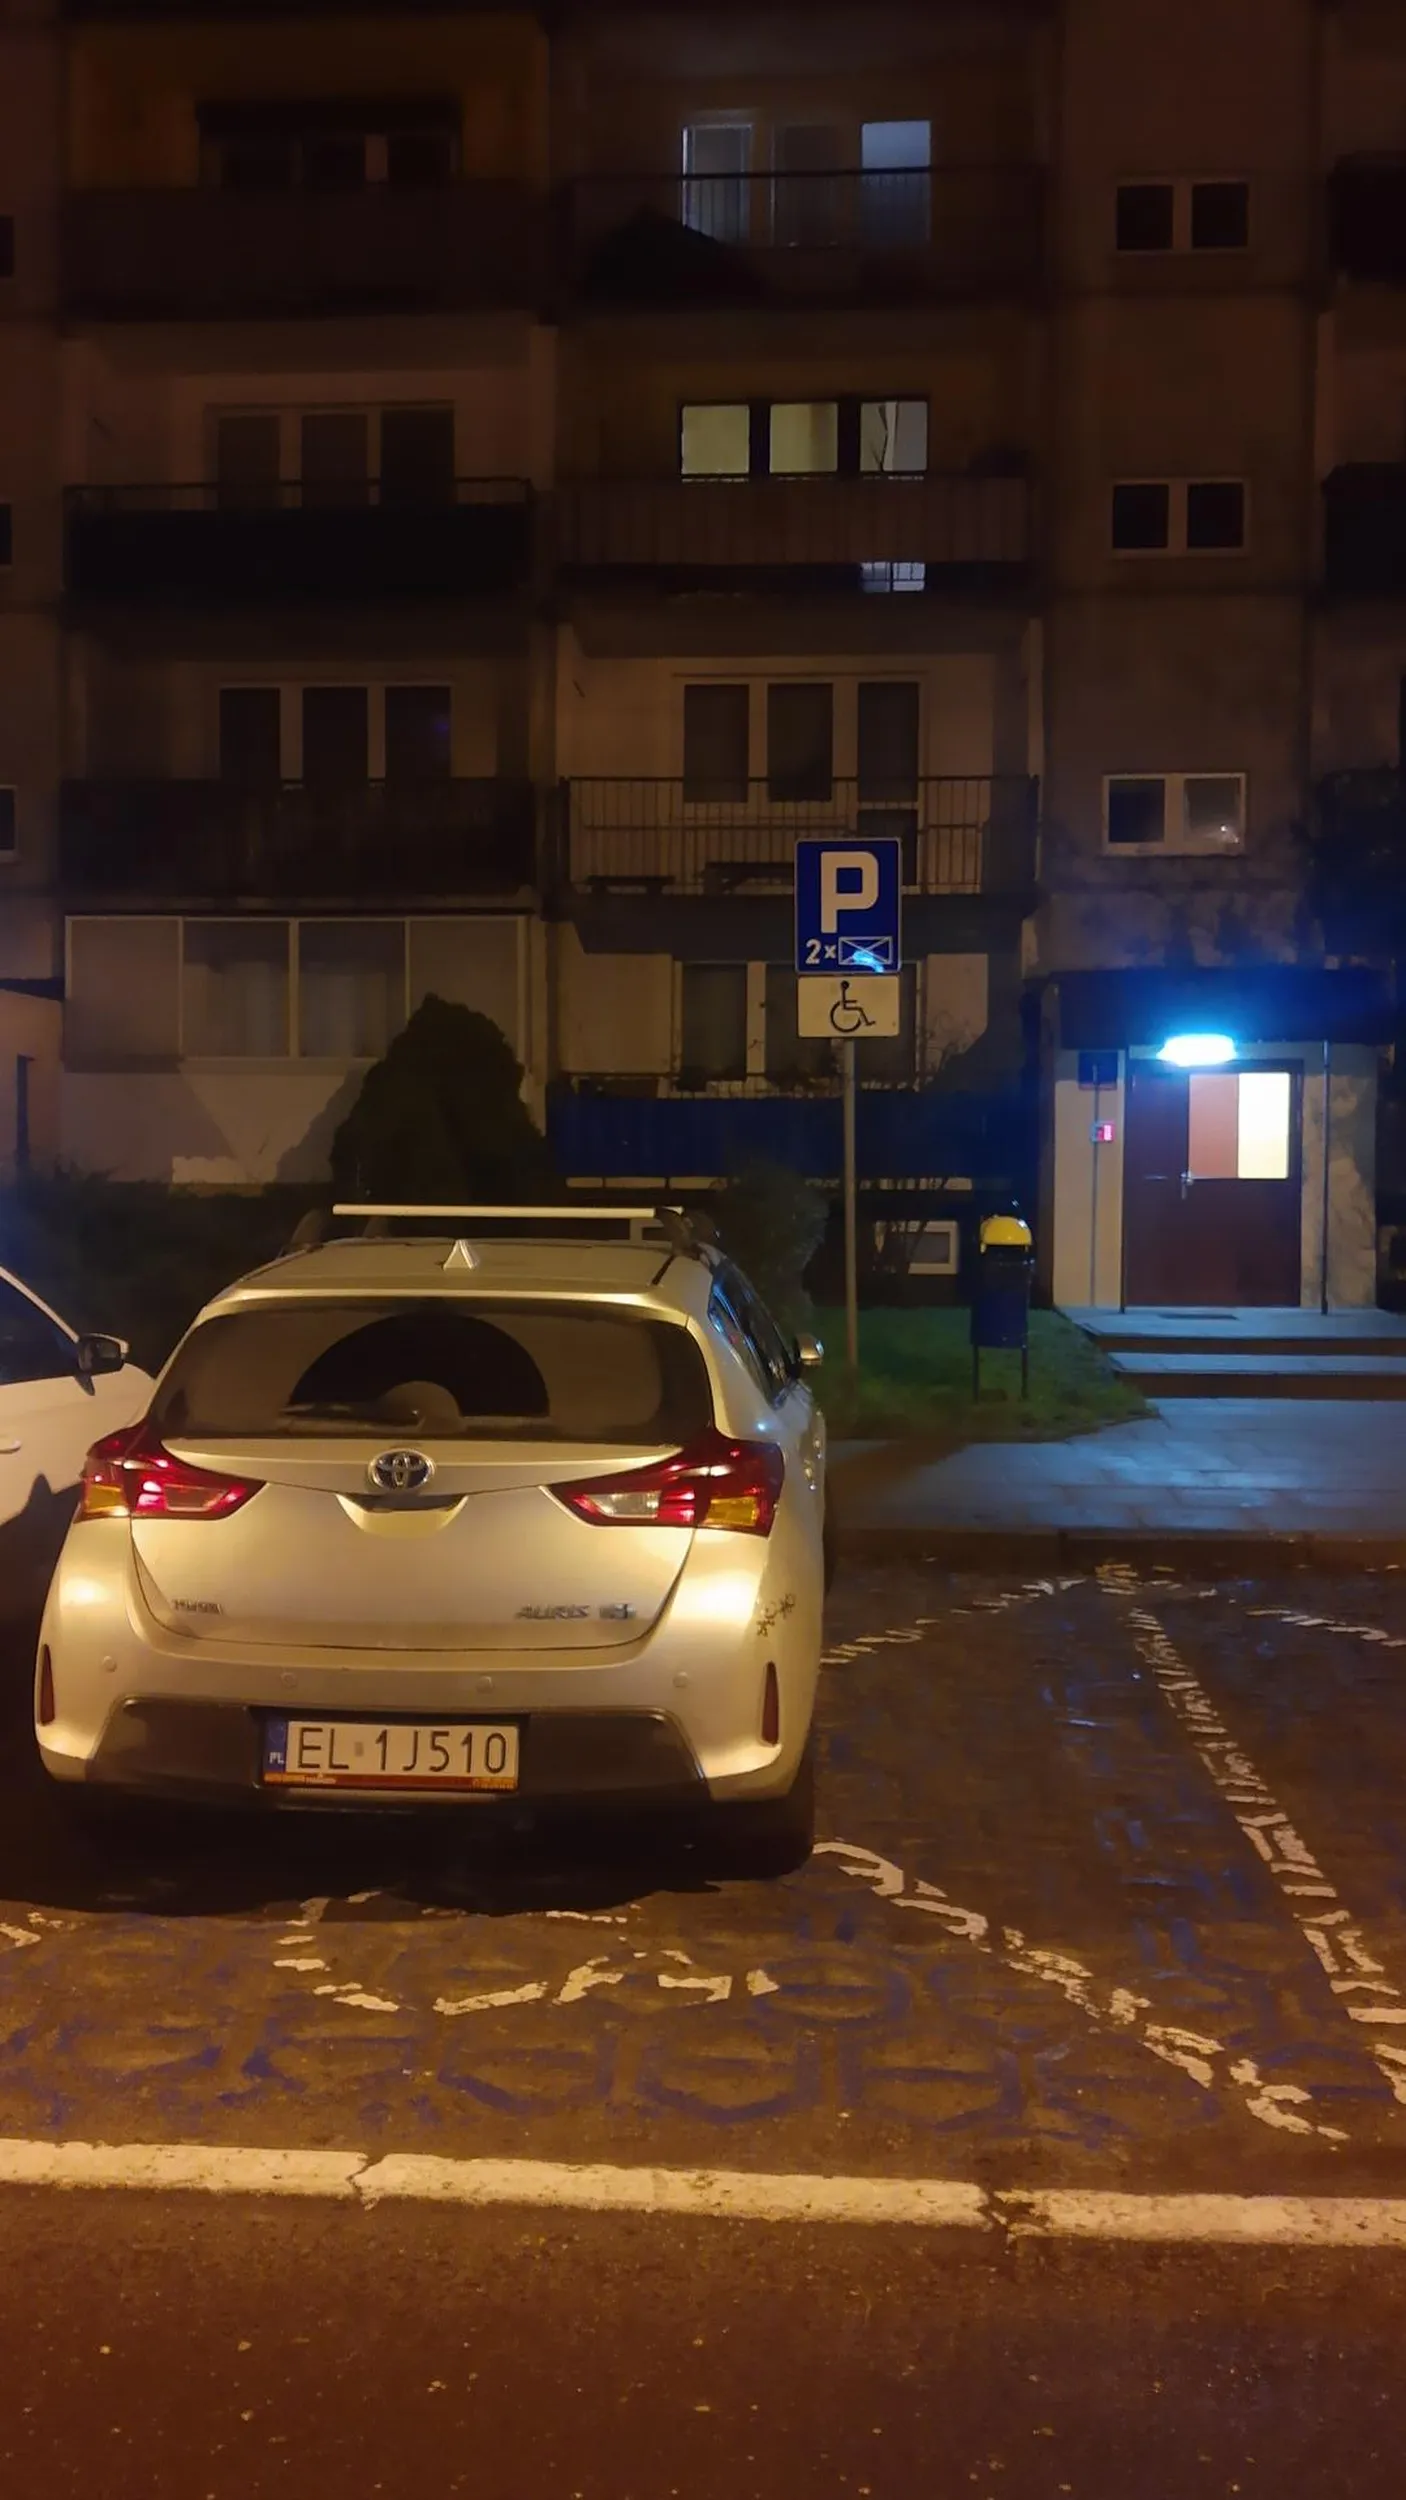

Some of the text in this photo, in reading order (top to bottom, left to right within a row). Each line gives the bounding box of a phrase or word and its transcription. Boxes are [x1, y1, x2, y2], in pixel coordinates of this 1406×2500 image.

[821, 852, 878, 933] P
[269, 1751, 285, 1765] PL
[297, 1727, 507, 1774] EL 1J510
